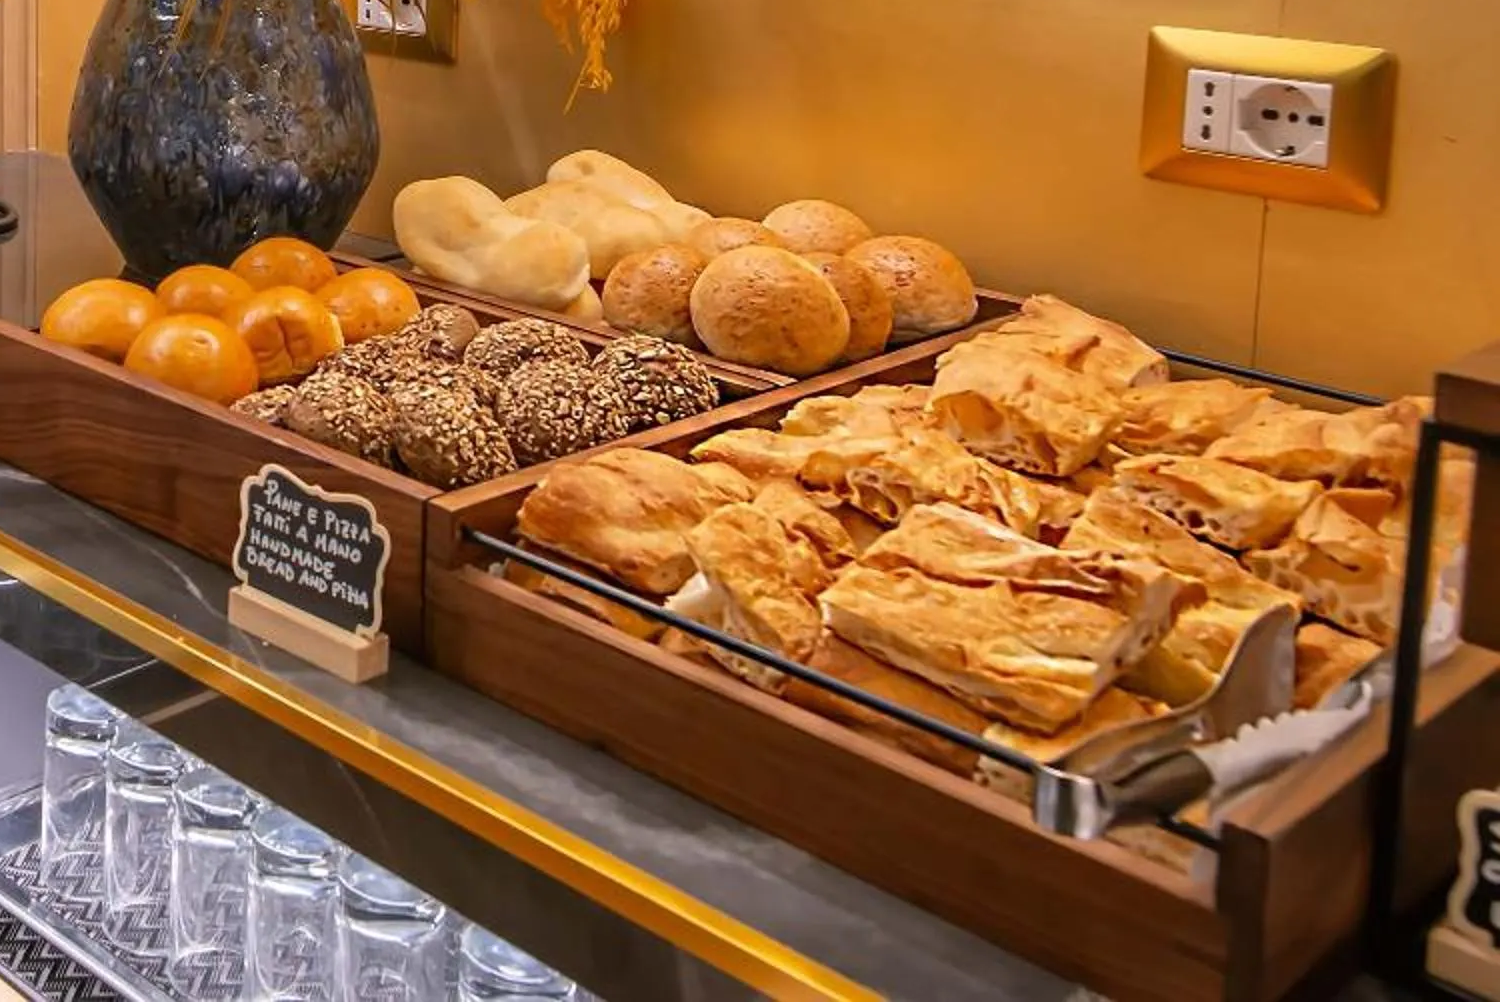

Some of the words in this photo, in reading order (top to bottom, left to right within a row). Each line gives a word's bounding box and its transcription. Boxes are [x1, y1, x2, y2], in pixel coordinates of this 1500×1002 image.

[263, 479, 303, 517] PANE
[307, 507, 319, 525] E
[324, 509, 371, 544] PIZZA
[296, 524, 309, 543] A
[315, 533, 362, 563] MANO
[246, 545, 295, 583] BREAD
[298, 570, 328, 593] AND
